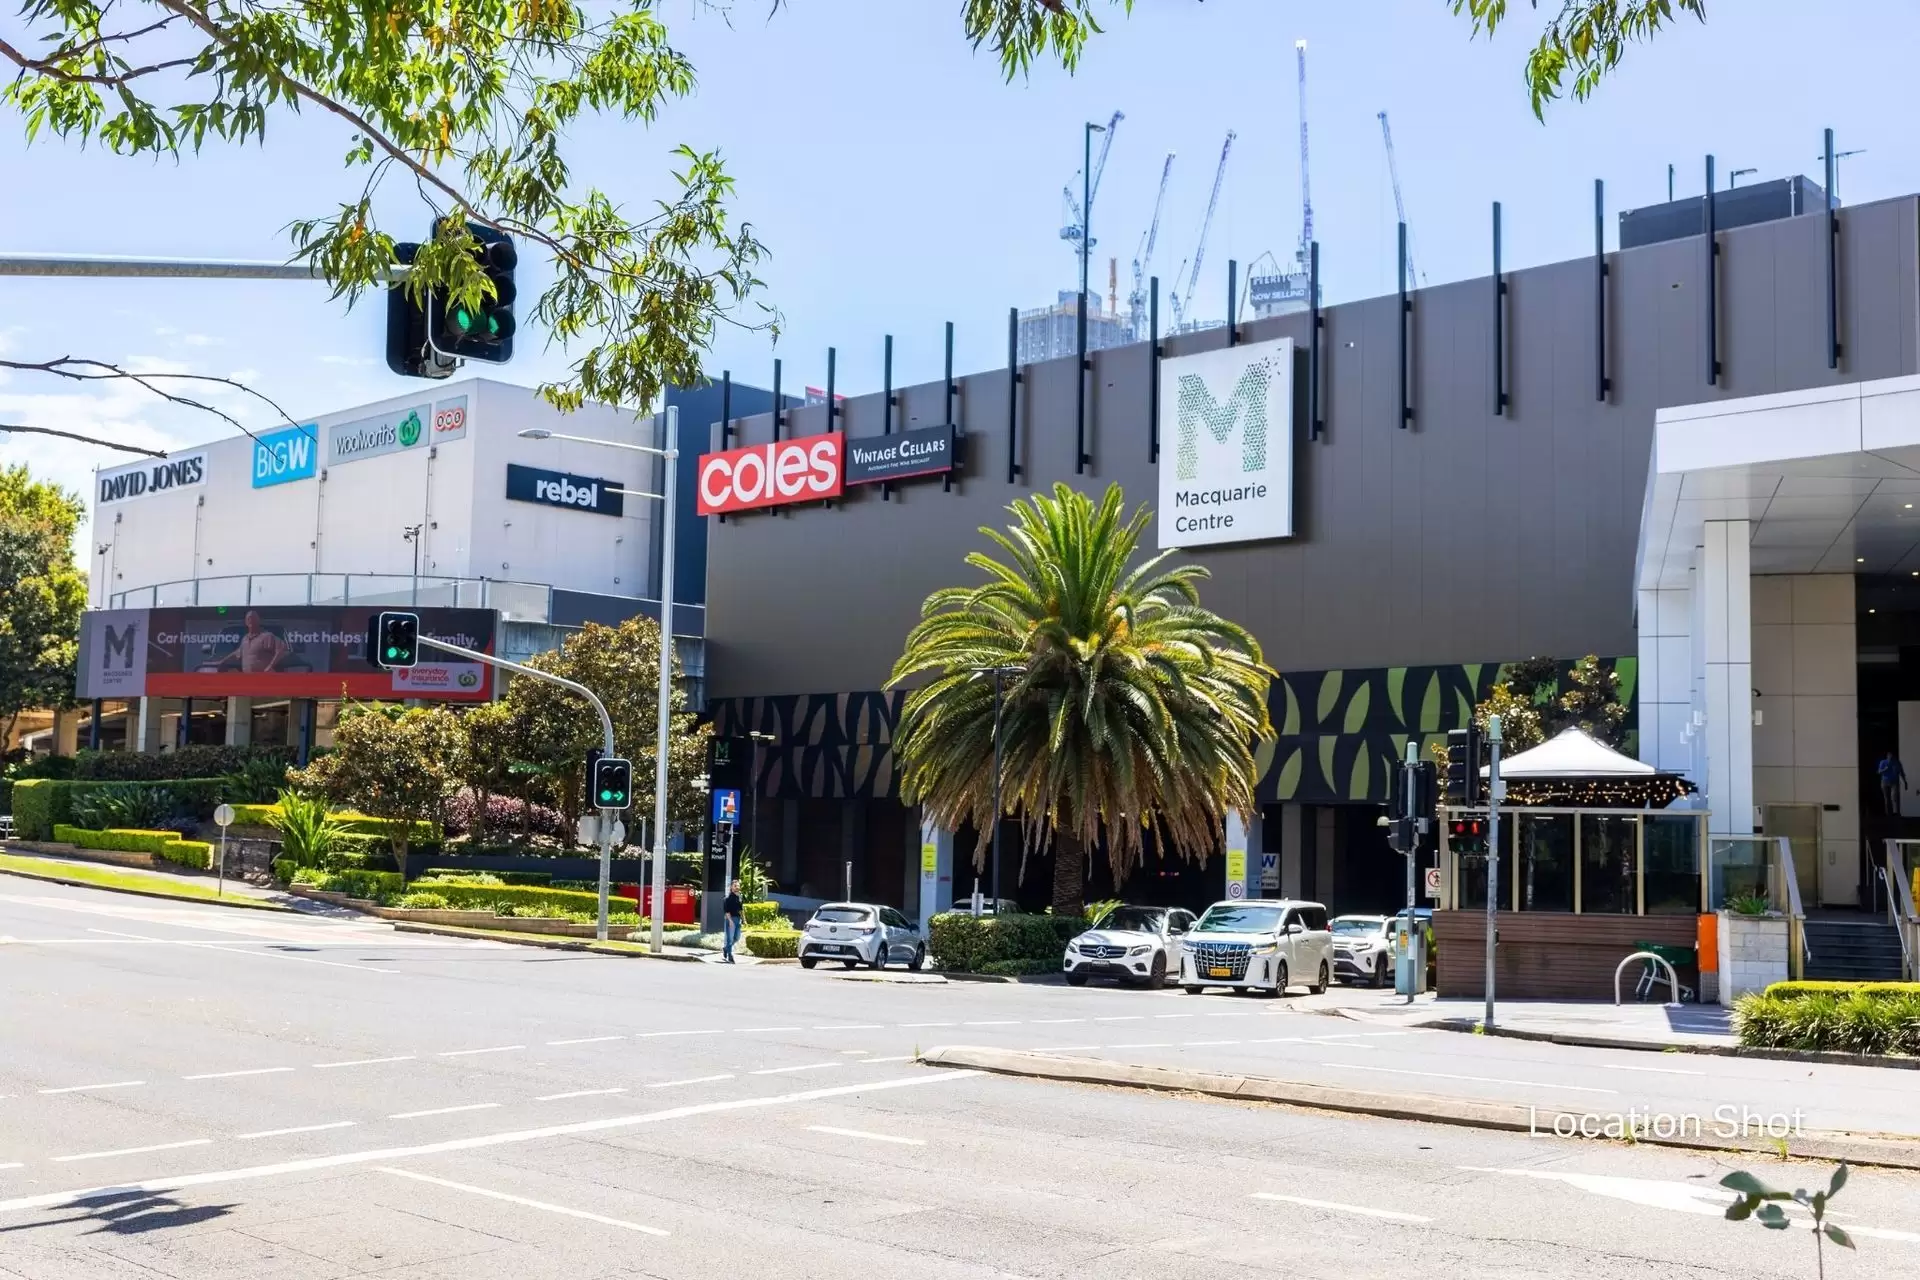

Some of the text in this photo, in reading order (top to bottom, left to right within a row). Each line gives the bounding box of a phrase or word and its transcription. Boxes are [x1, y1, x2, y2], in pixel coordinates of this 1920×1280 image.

[853, 439, 945, 465] VINTAGE CELLARS
[100, 457, 203, 502] DAVID JONES
[700, 440, 837, 507] coles
[536, 478, 598, 508] rebel
[1176, 482, 1267, 508] Macquarie
[1175, 514, 1234, 532] Centre
[157, 631, 177, 644] Car
[179, 632, 240, 644] insurance
[287, 631, 320, 643] that
[321, 630, 361, 647] helps
